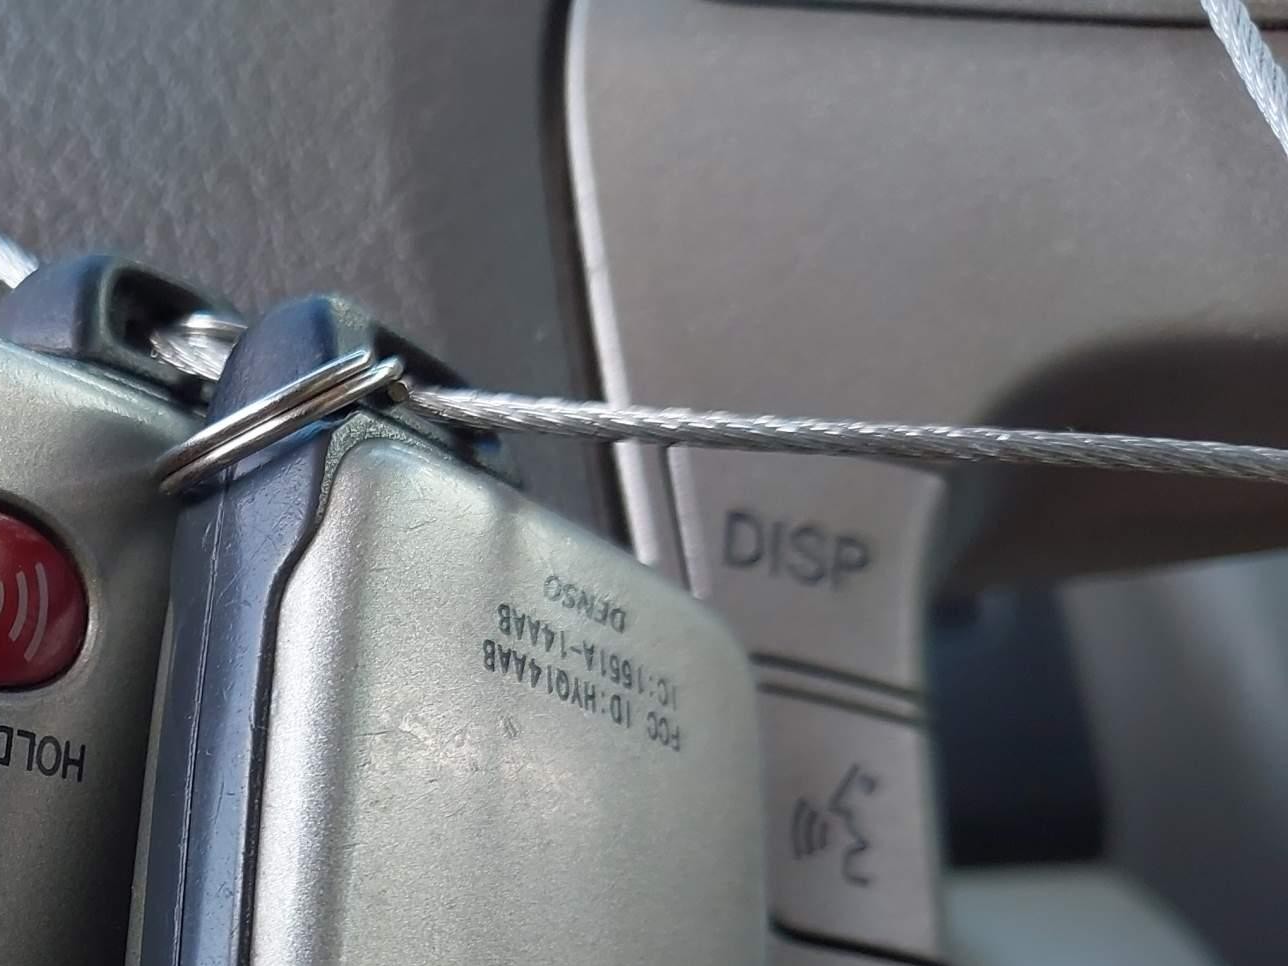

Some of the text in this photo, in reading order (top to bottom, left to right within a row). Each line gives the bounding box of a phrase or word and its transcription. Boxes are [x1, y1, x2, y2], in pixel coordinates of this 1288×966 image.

[723, 509, 872, 593] DISP
[543, 576, 626, 633] DENSO
[481, 640, 681, 751] FCC ID:HYQ14AAB
